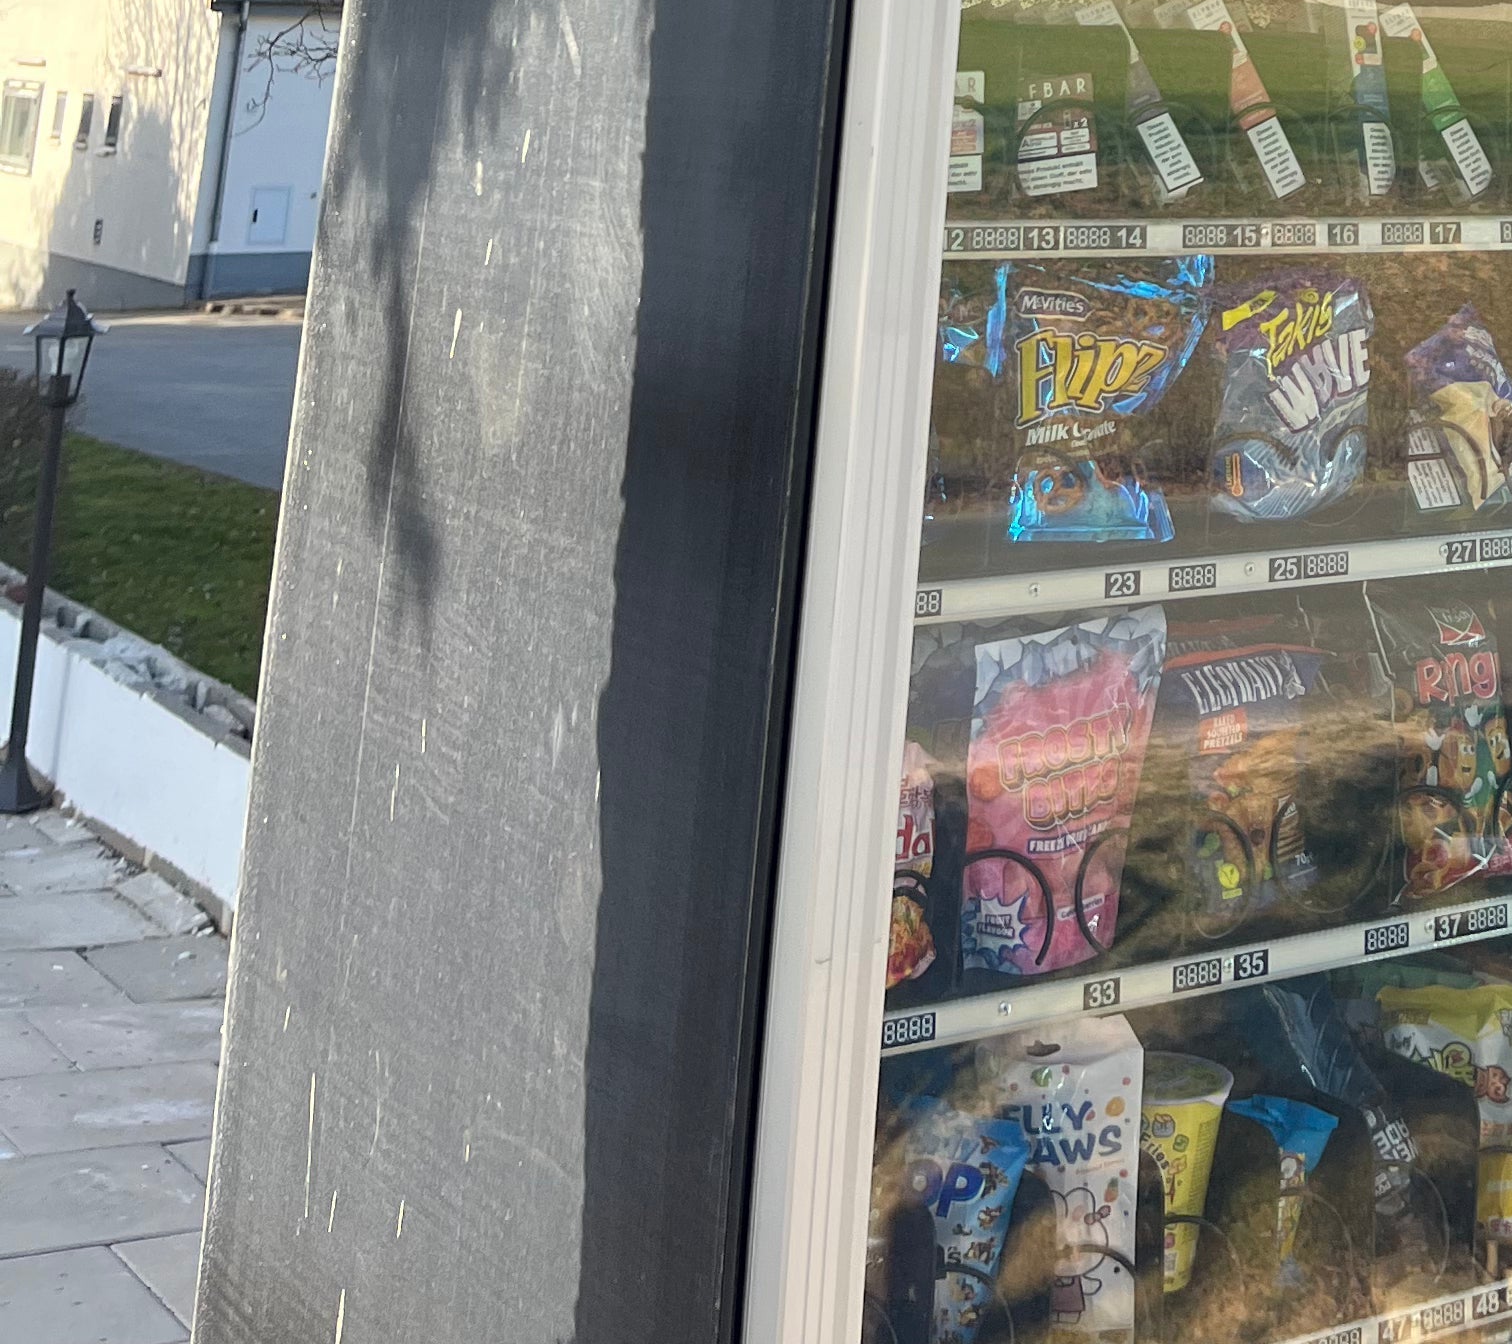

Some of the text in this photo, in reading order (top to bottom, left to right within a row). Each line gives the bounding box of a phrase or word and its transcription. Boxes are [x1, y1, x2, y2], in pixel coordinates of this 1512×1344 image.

[972, 228, 1019, 250] 8888
[1028, 227, 1056, 250] 13
[1065, 227, 1111, 249] 8888
[1117, 227, 1143, 248] 14
[1185, 226, 1227, 246] 8888
[1233, 225, 1258, 246] 15
[1274, 225, 1316, 245] 8888
[1332, 225, 1355, 245] 16
[1382, 223, 1424, 243] 8888
[1435, 223, 1457, 243] 17
[1015, 327, 1168, 428] Flipz
[1025, 423, 1070, 447] Milk
[1109, 573, 1136, 597] 23
[1171, 565, 1215, 589] 8888
[1273, 558, 1297, 581] 25
[1306, 553, 1347, 577] 8888
[1450, 542, 1473, 563] 27
[884, 1015, 934, 1045] 8888
[1087, 981, 1116, 1007] 33
[1175, 959, 1220, 988] 8888
[1238, 952, 1266, 978] 35
[1367, 924, 1408, 951] 8888
[1439, 916, 1462, 939] 37
[1467, 905, 1507, 932] 8888
[1141, 1131, 1171, 1171] Fries
[1475, 1290, 1499, 1315] 48
